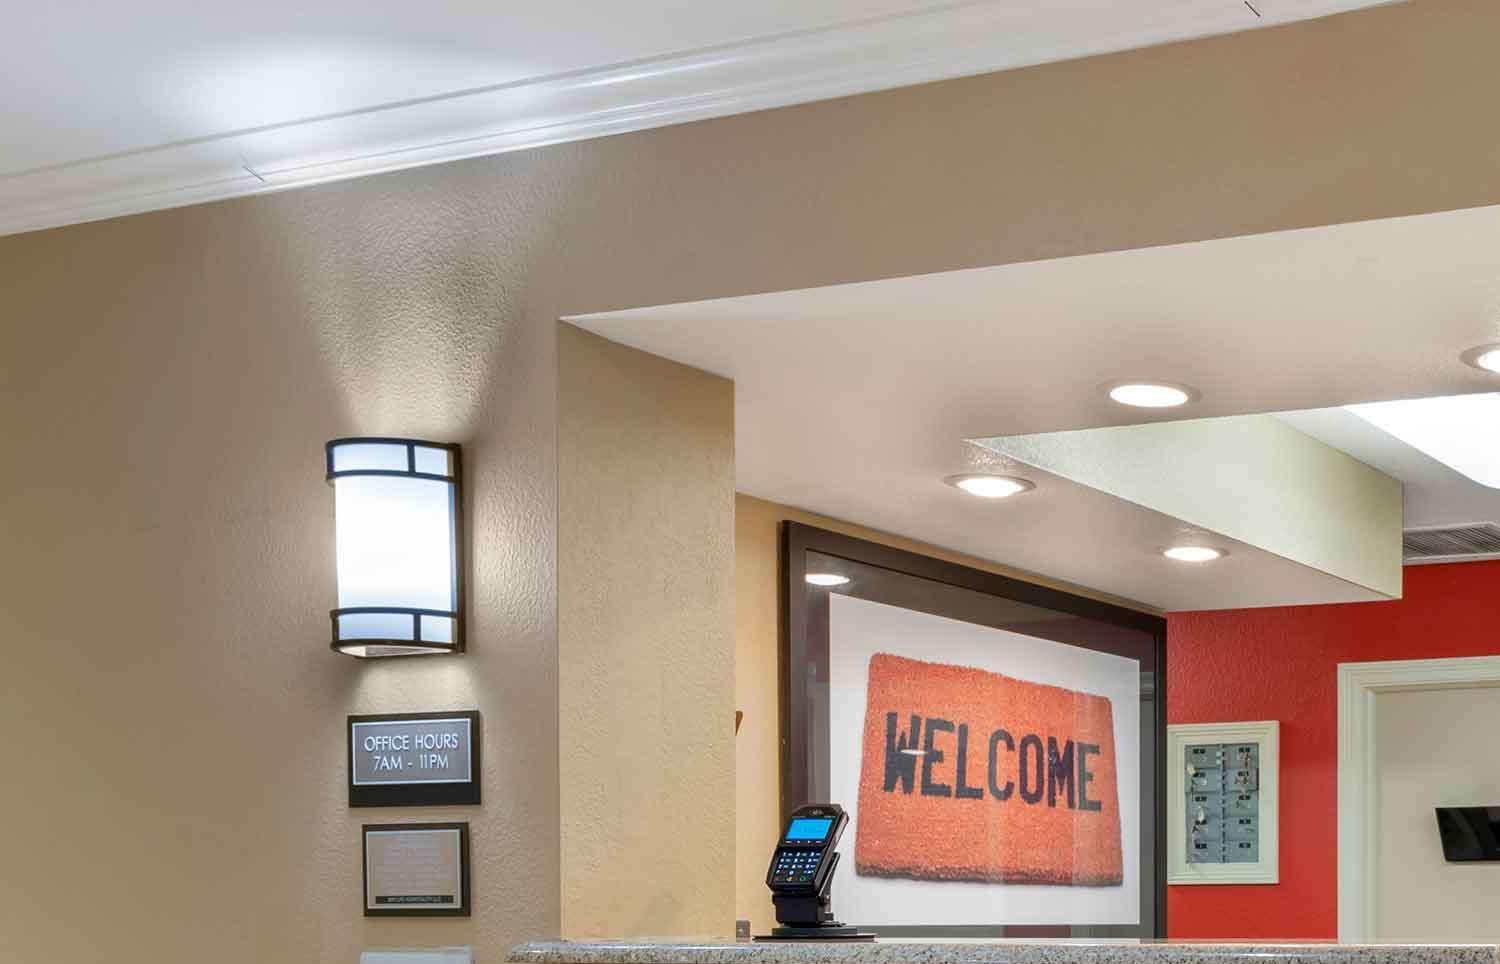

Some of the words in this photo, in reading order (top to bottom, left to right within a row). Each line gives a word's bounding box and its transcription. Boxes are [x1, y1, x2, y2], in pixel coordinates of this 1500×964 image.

[364, 736, 409, 751] OFFICE
[415, 733, 458, 749] HOURS
[373, 755, 402, 770] 7AM
[420, 753, 449, 769] 11PM
[883, 711, 1102, 812] WELCOME
